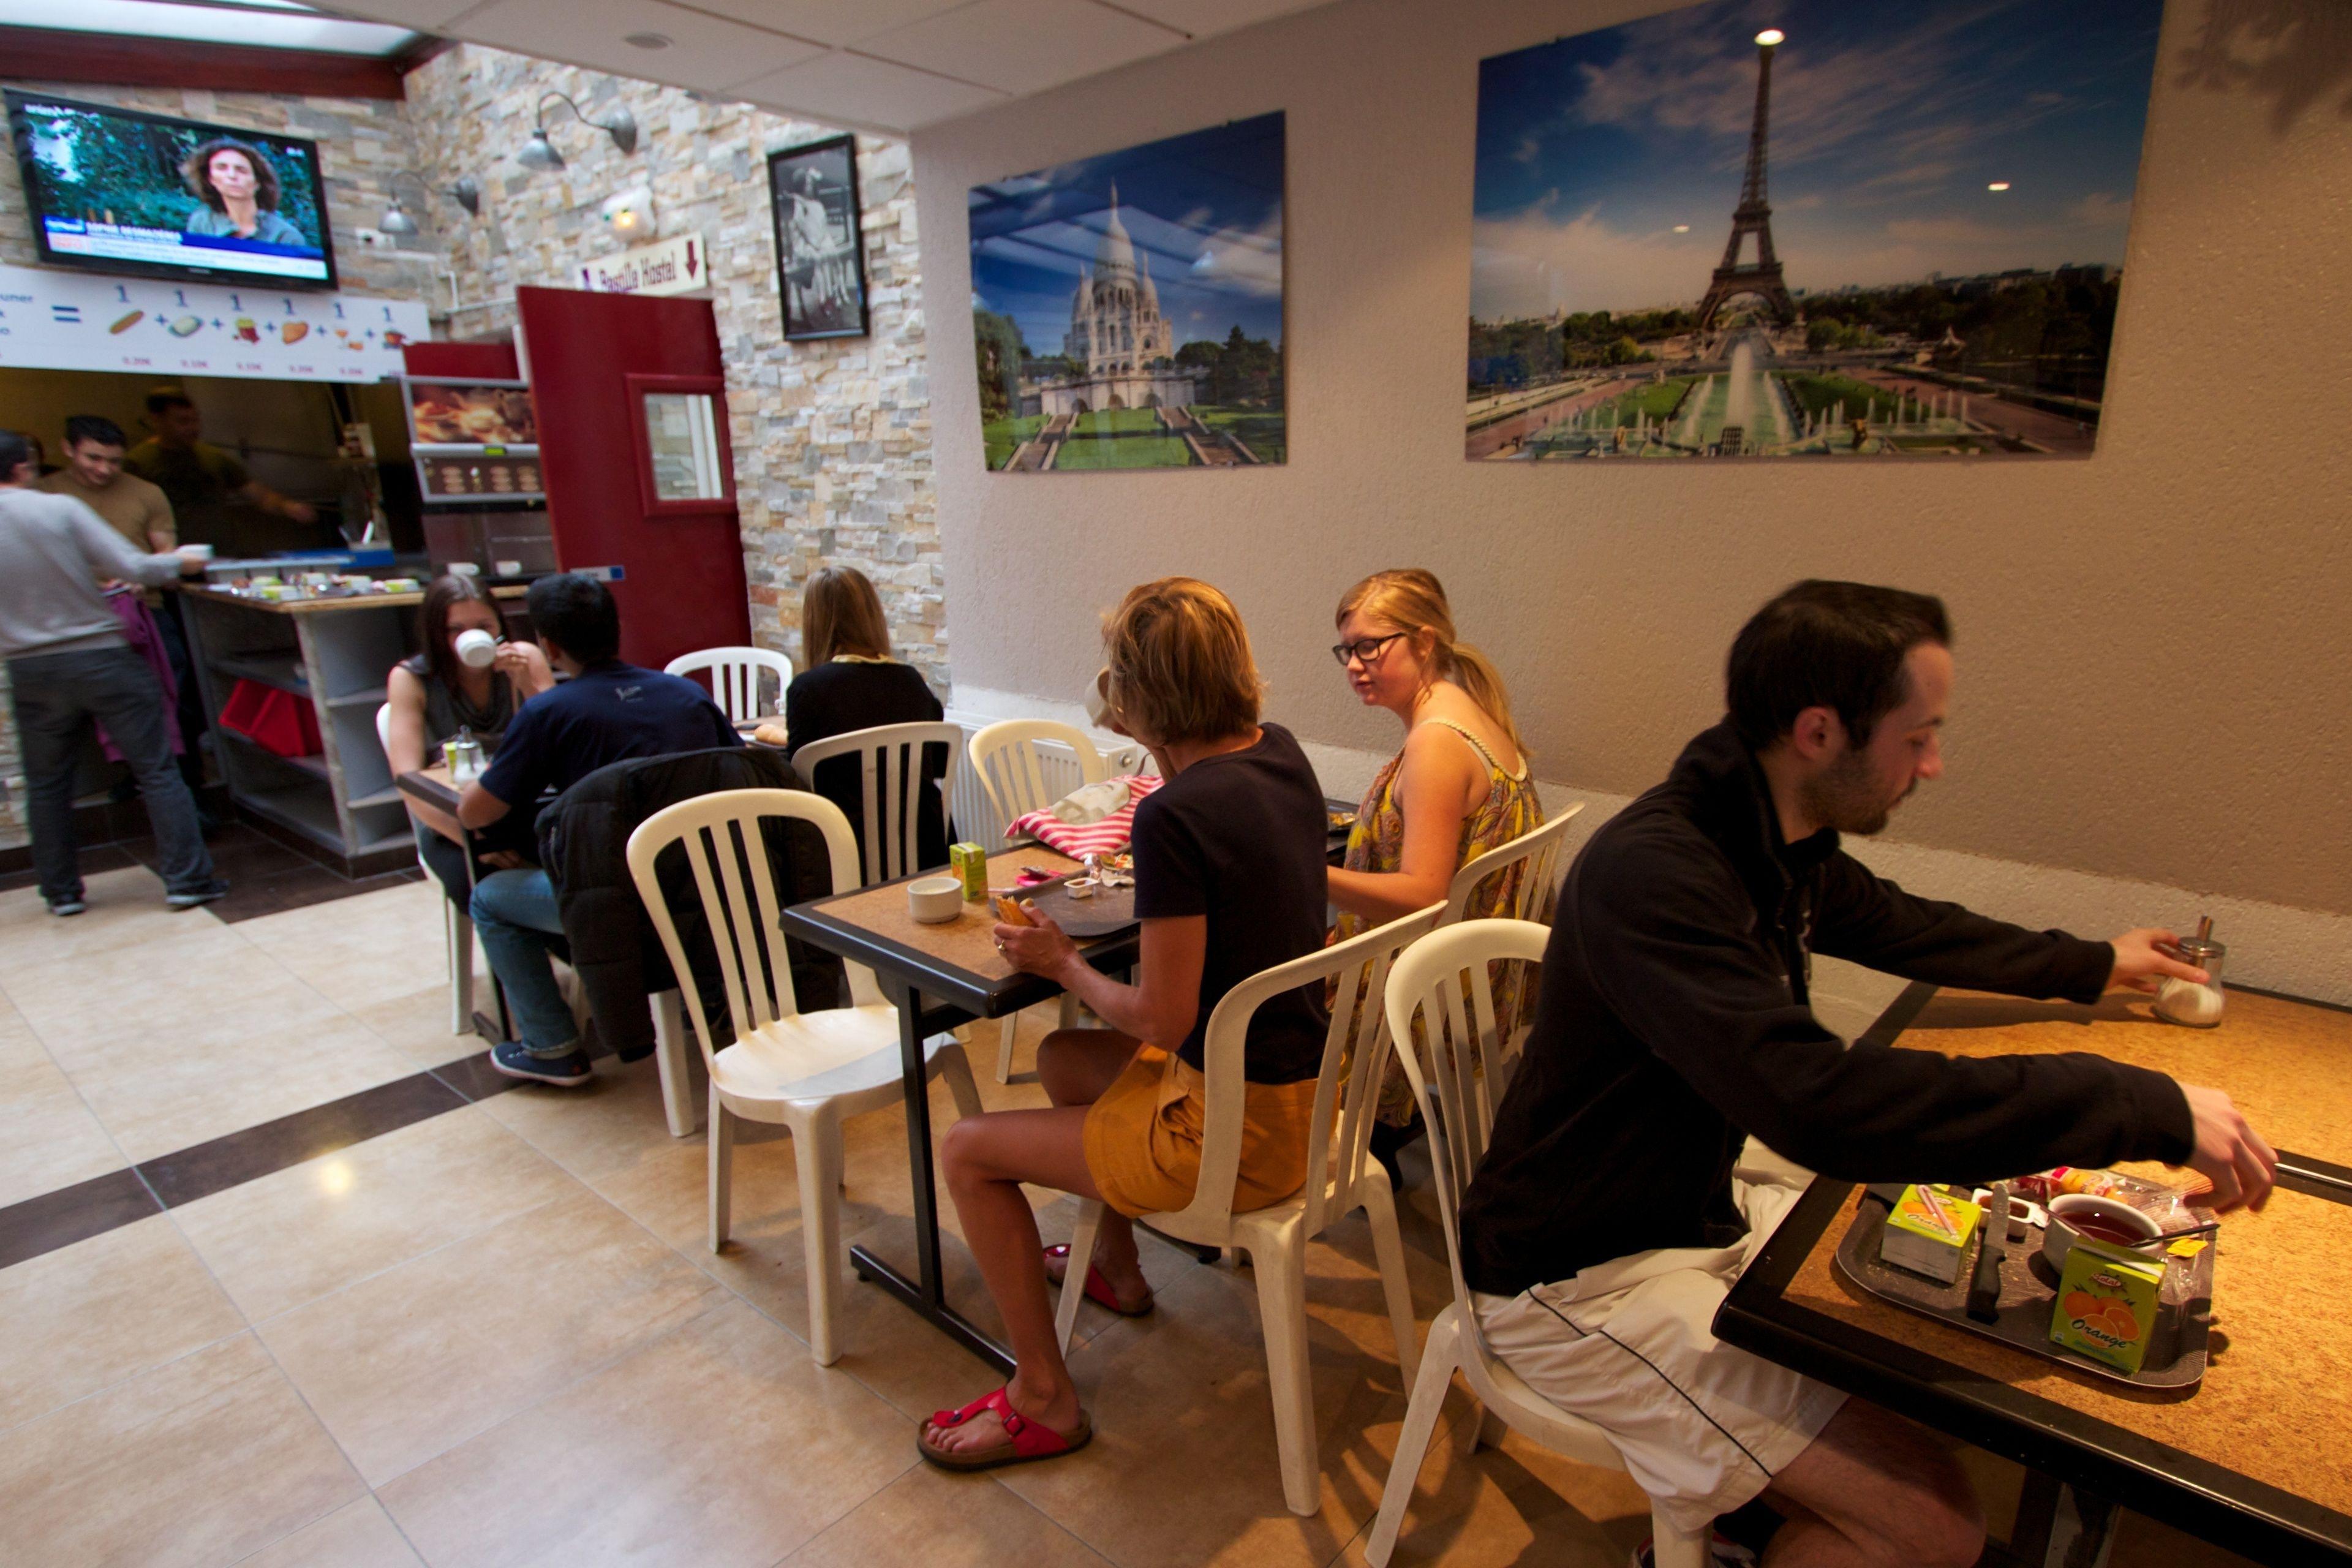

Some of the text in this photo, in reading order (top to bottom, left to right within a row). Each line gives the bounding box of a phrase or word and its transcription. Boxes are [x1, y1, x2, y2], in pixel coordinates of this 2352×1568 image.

[116, 284, 393, 322] 1 1 1 1 1 1
[2071, 1319, 2127, 1348] Orange
